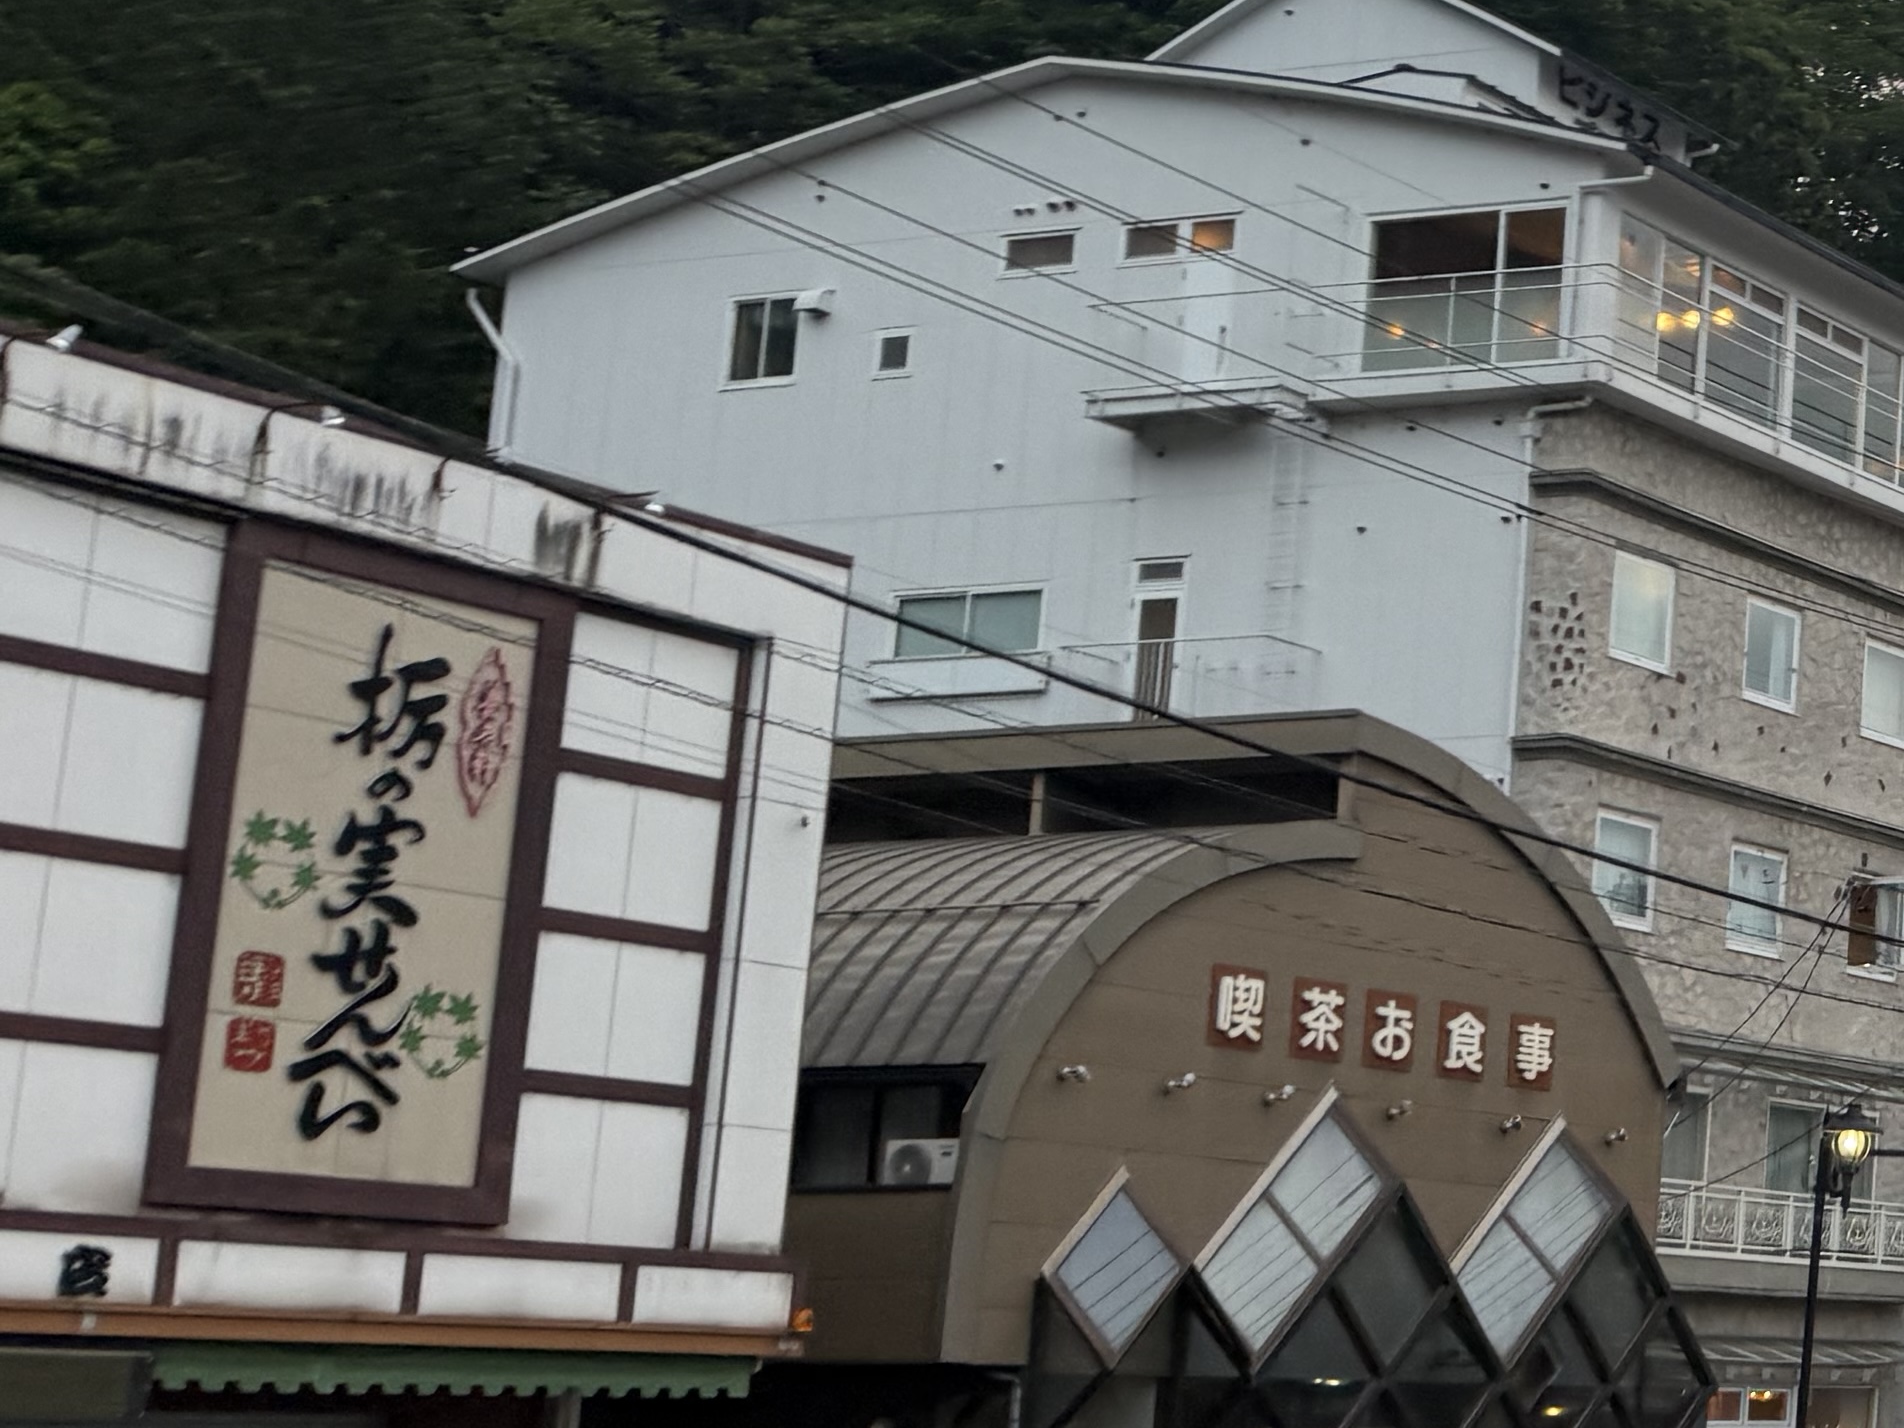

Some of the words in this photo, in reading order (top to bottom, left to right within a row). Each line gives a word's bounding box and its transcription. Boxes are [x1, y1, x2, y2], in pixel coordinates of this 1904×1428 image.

[289, 623, 450, 1139] 栃の実せんべい
[1215, 973, 1555, 1083] 喫茶お食事
